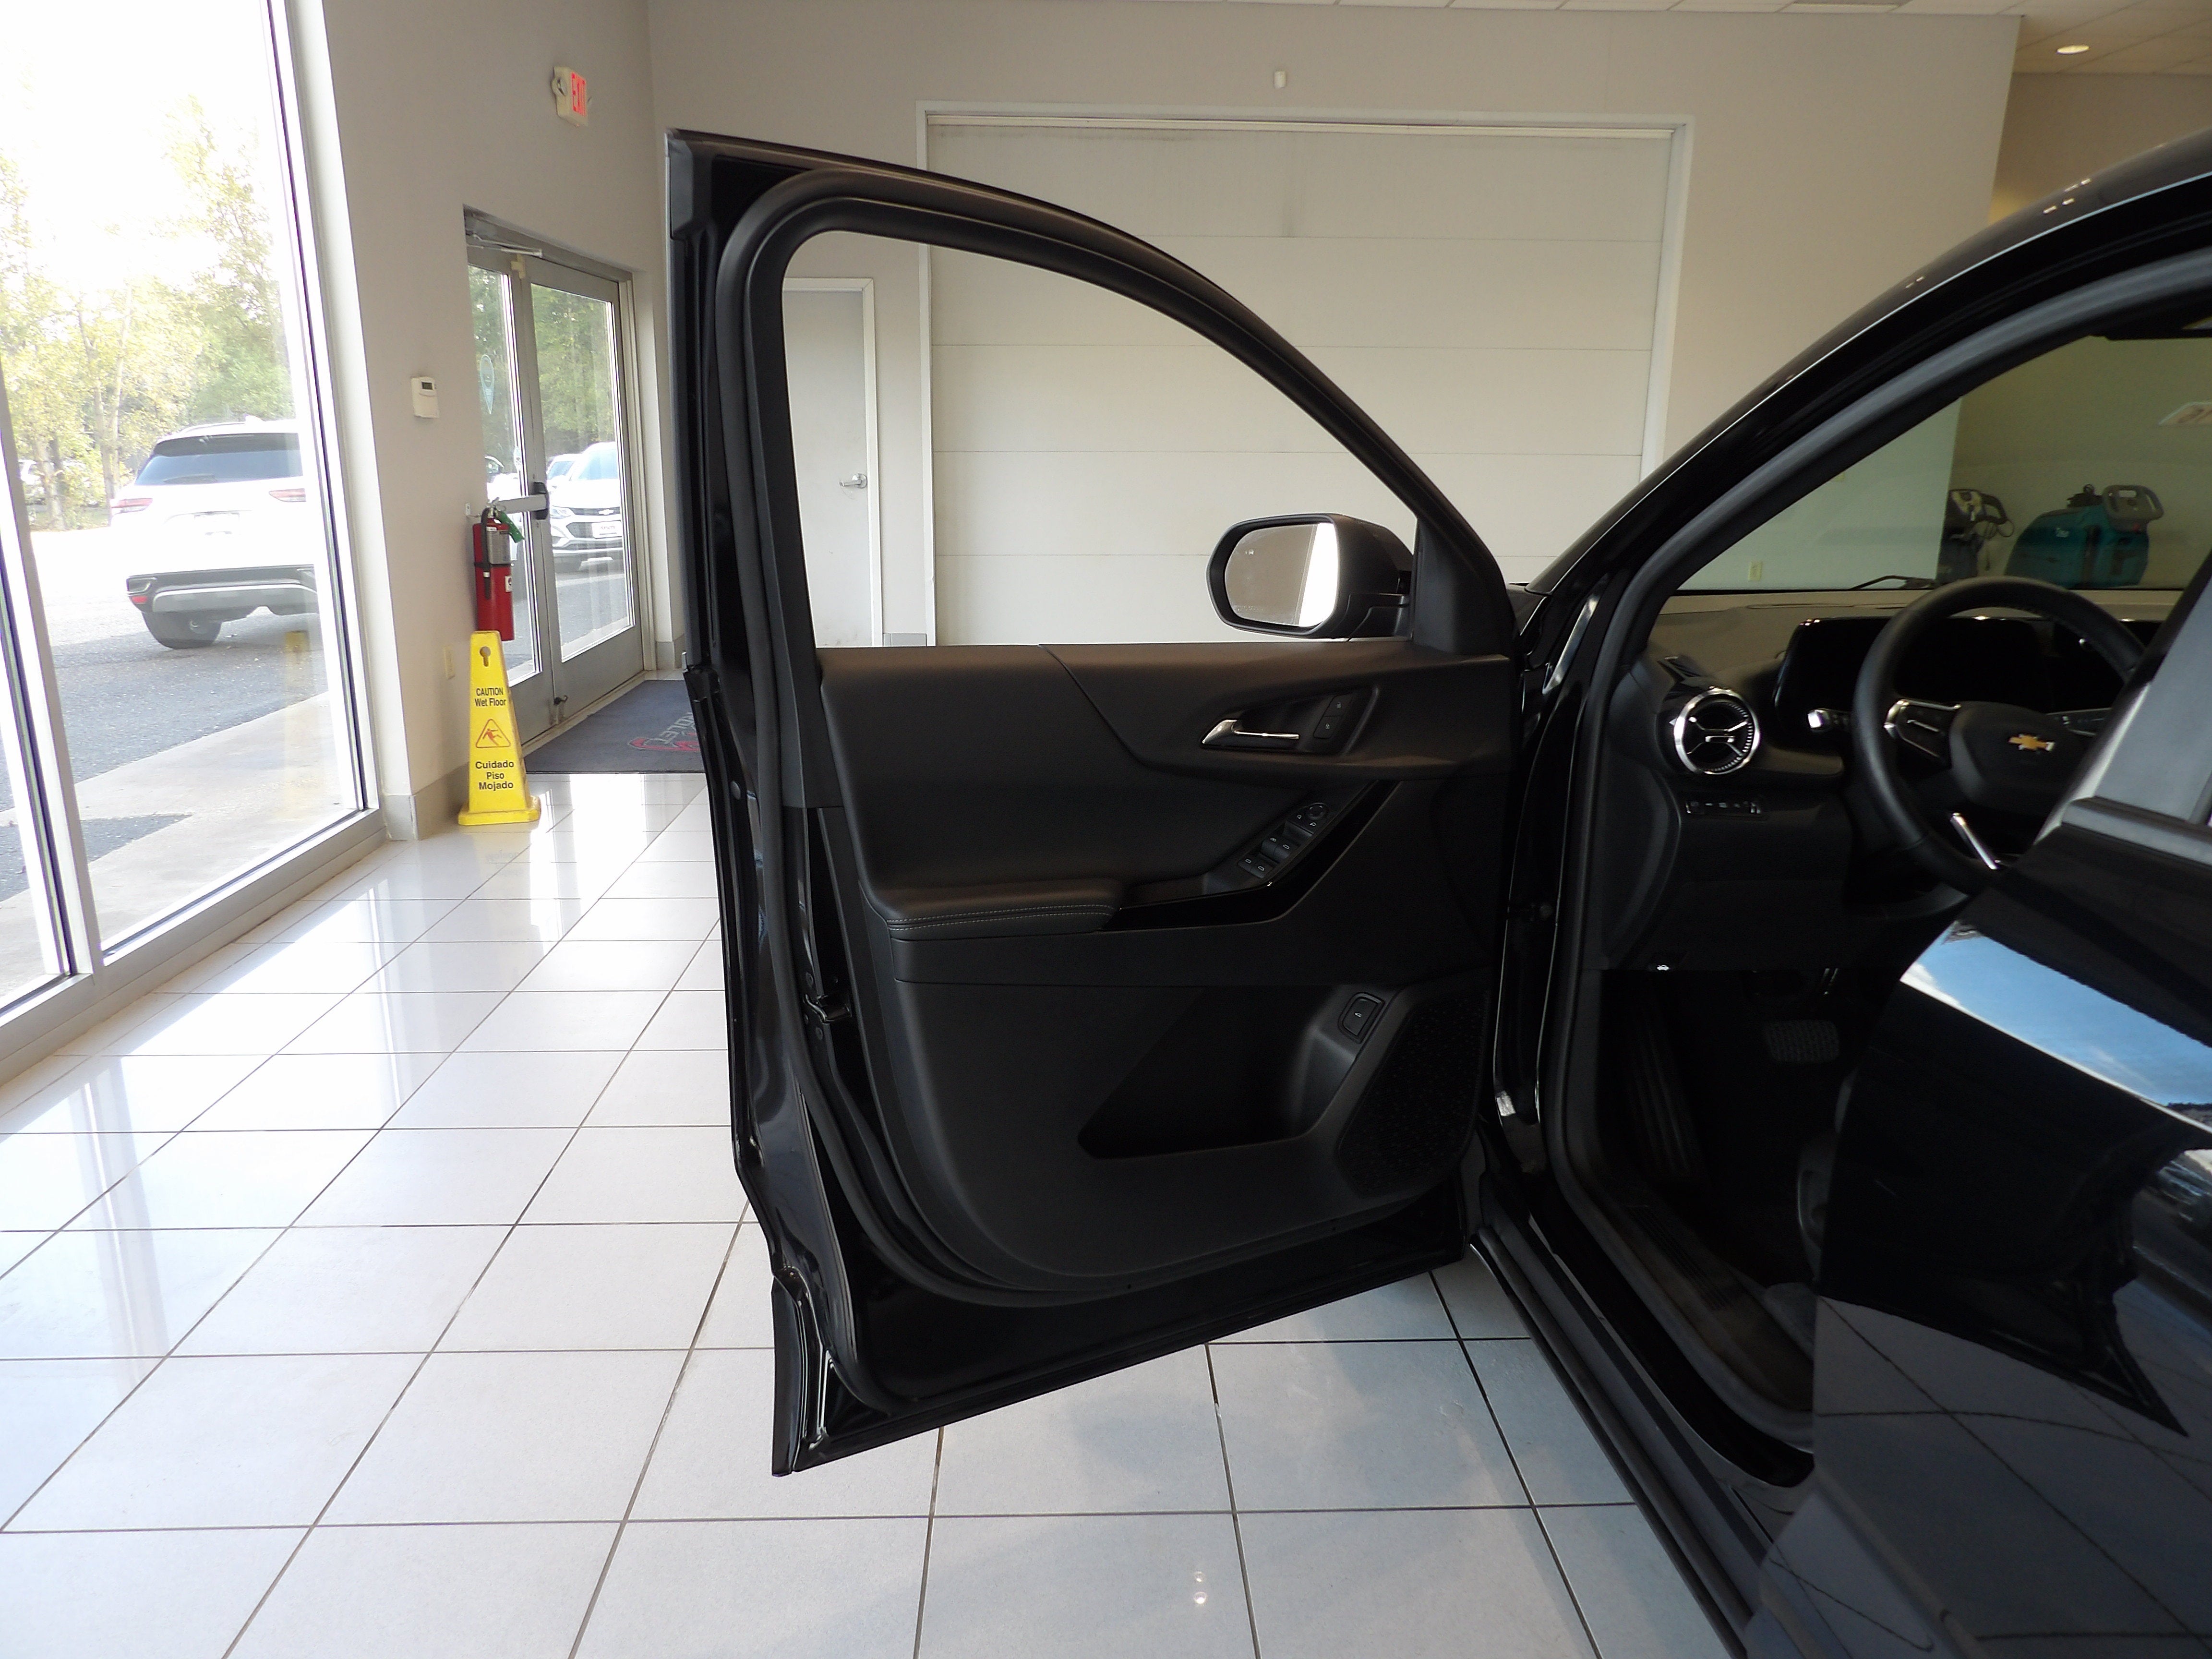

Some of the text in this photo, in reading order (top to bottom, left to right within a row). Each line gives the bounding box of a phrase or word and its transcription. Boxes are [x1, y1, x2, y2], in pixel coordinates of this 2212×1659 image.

[476, 687, 504, 696] CAUTION
[474, 697, 506, 707] Wet Floor
[475, 760, 514, 769] Cuidado
[486, 771, 505, 780] Piso
[479, 781, 514, 792] Mojado
